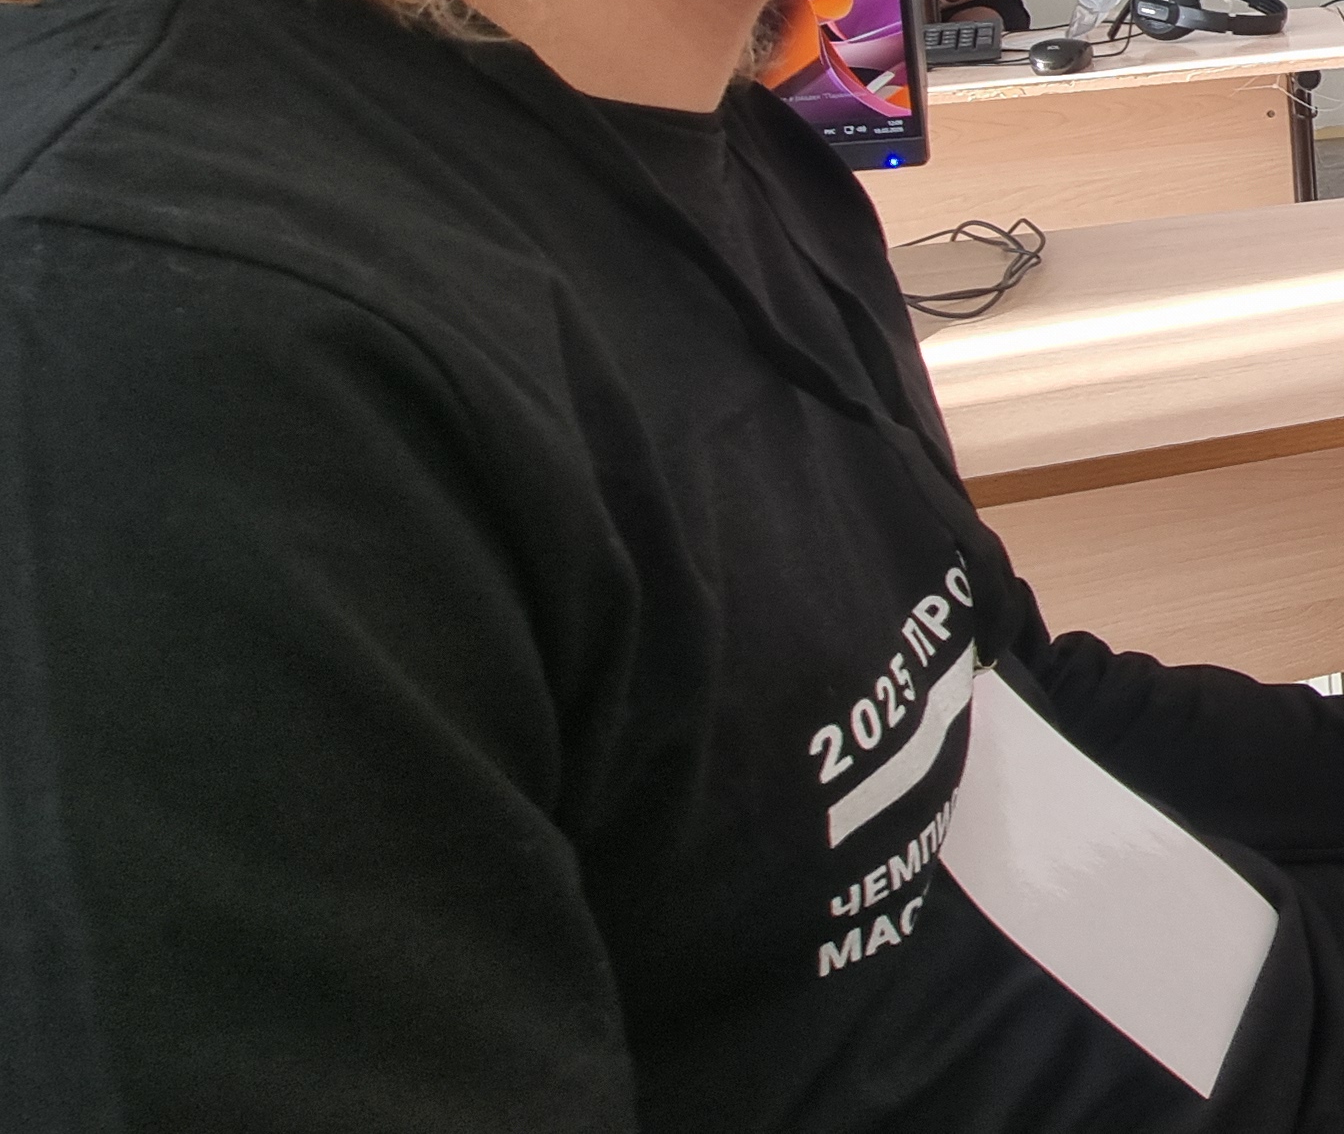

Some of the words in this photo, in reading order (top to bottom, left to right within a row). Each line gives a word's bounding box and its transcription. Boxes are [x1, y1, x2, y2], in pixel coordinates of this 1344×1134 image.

[809, 652, 916, 784] 2025
[902, 550, 974, 667] ПРО
[818, 886, 927, 977] МАС
